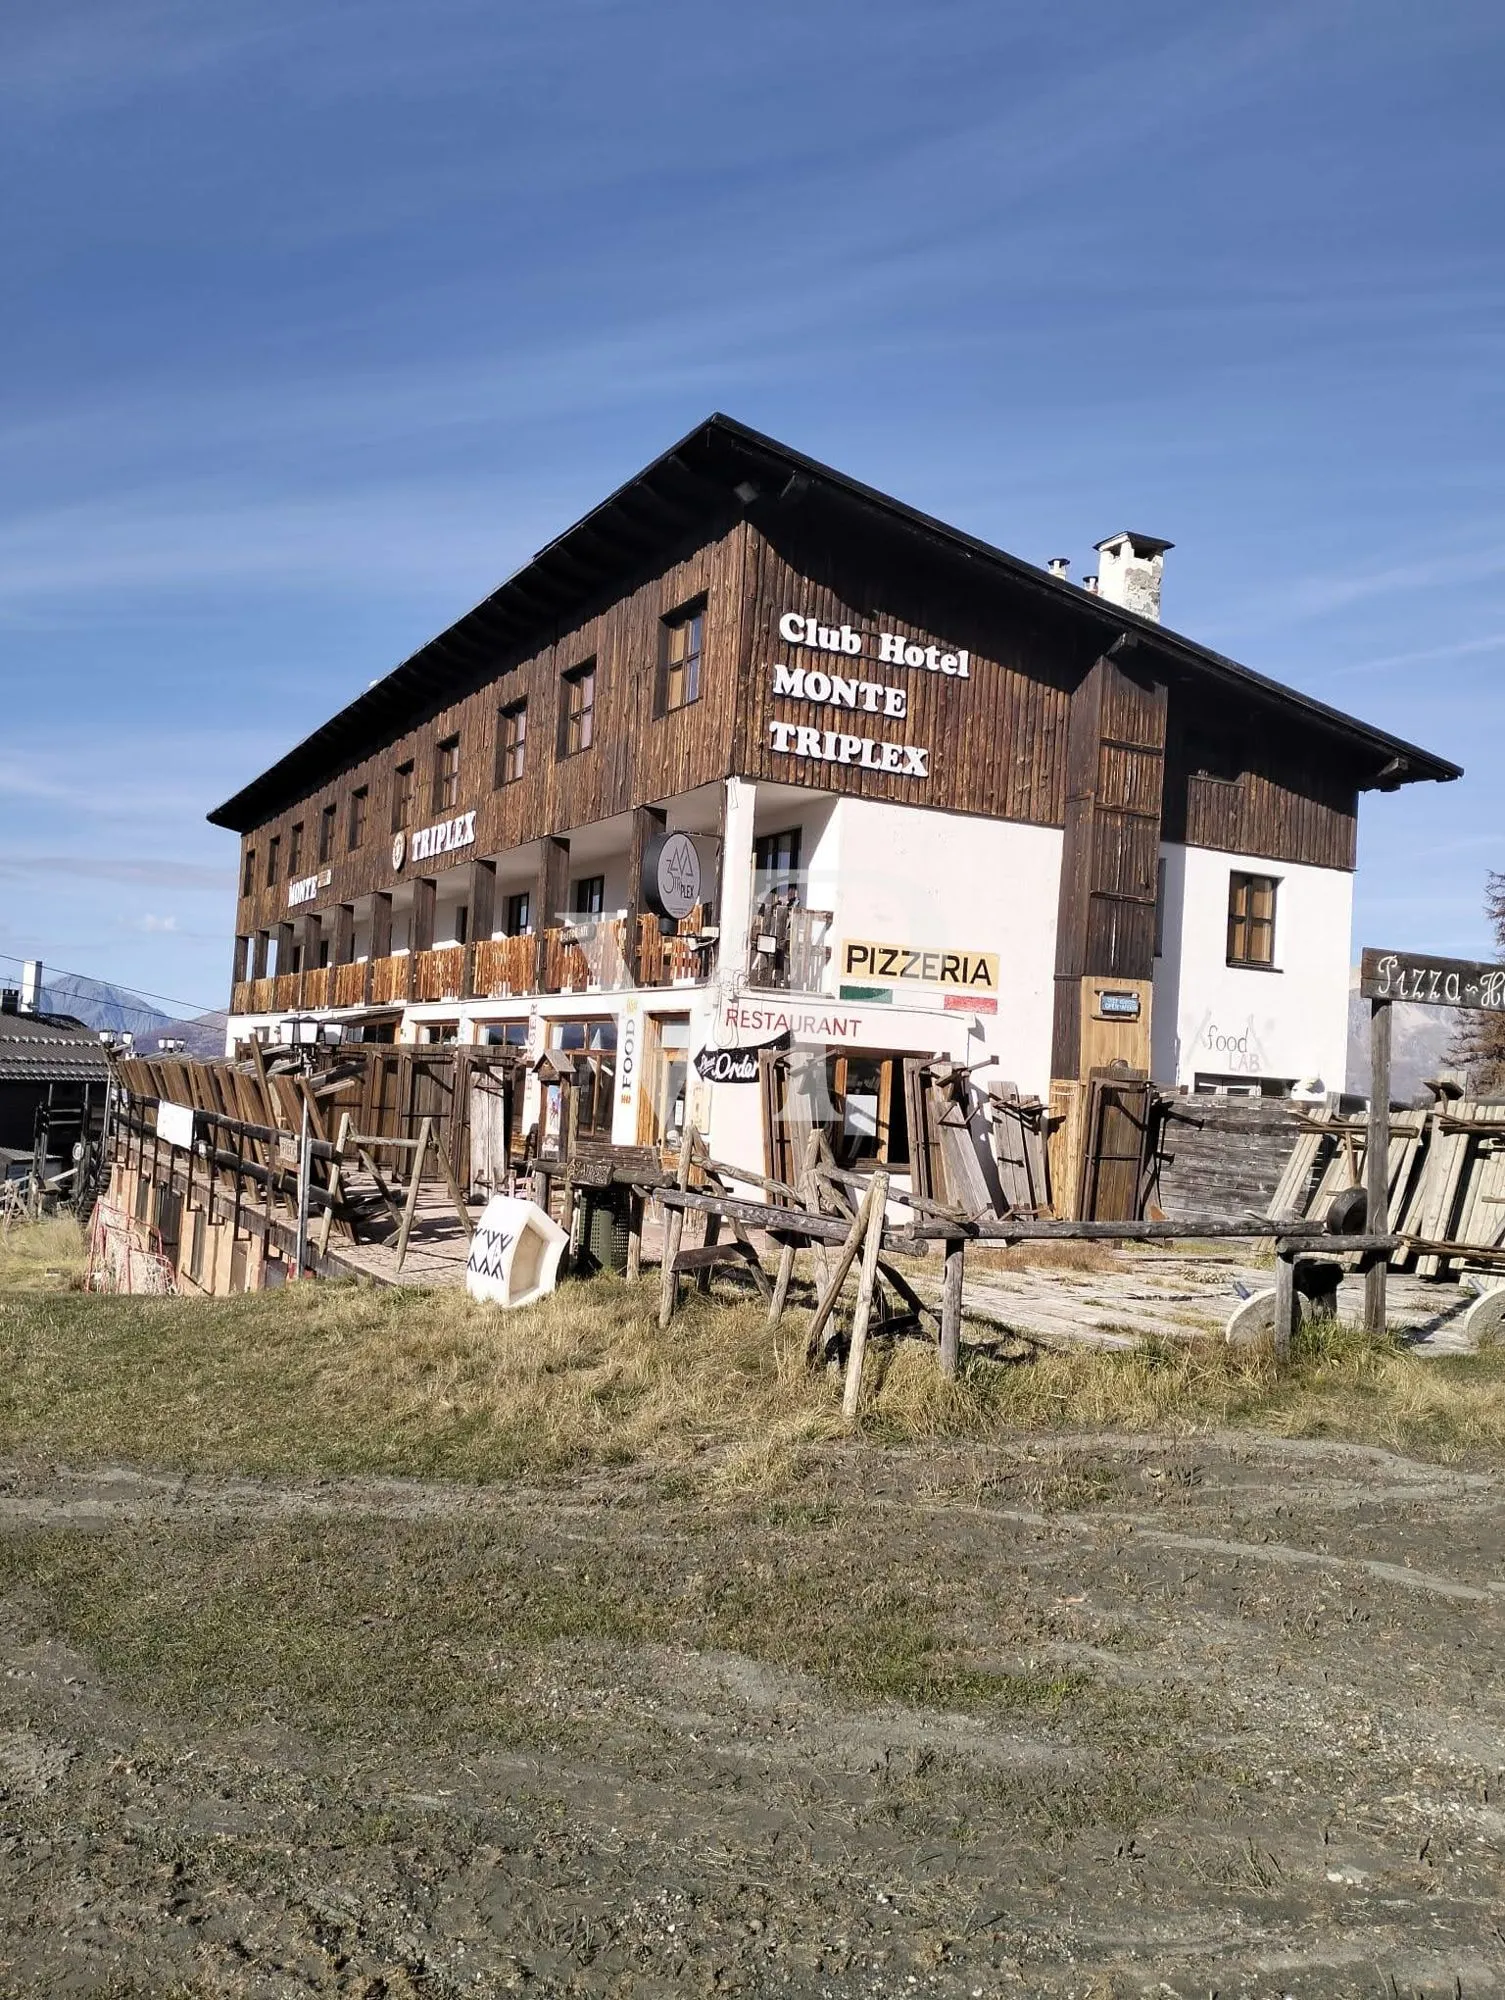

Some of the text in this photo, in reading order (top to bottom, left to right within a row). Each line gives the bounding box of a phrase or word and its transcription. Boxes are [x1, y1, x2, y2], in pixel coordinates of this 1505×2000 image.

[779, 613, 970, 678] Club Hotel
[773, 664, 907, 719] MONTE
[769, 721, 930, 778] TRIPLEX
[411, 810, 477, 862] TRIPLEX
[288, 874, 318, 907] MONTE
[846, 944, 992, 986] PIZZERIA
[726, 1008, 862, 1037] RESTAURANT
[1208, 1025, 1248, 1053] food
[622, 1019, 635, 1090] FOOD
[1229, 1052, 1260, 1073] LAB
